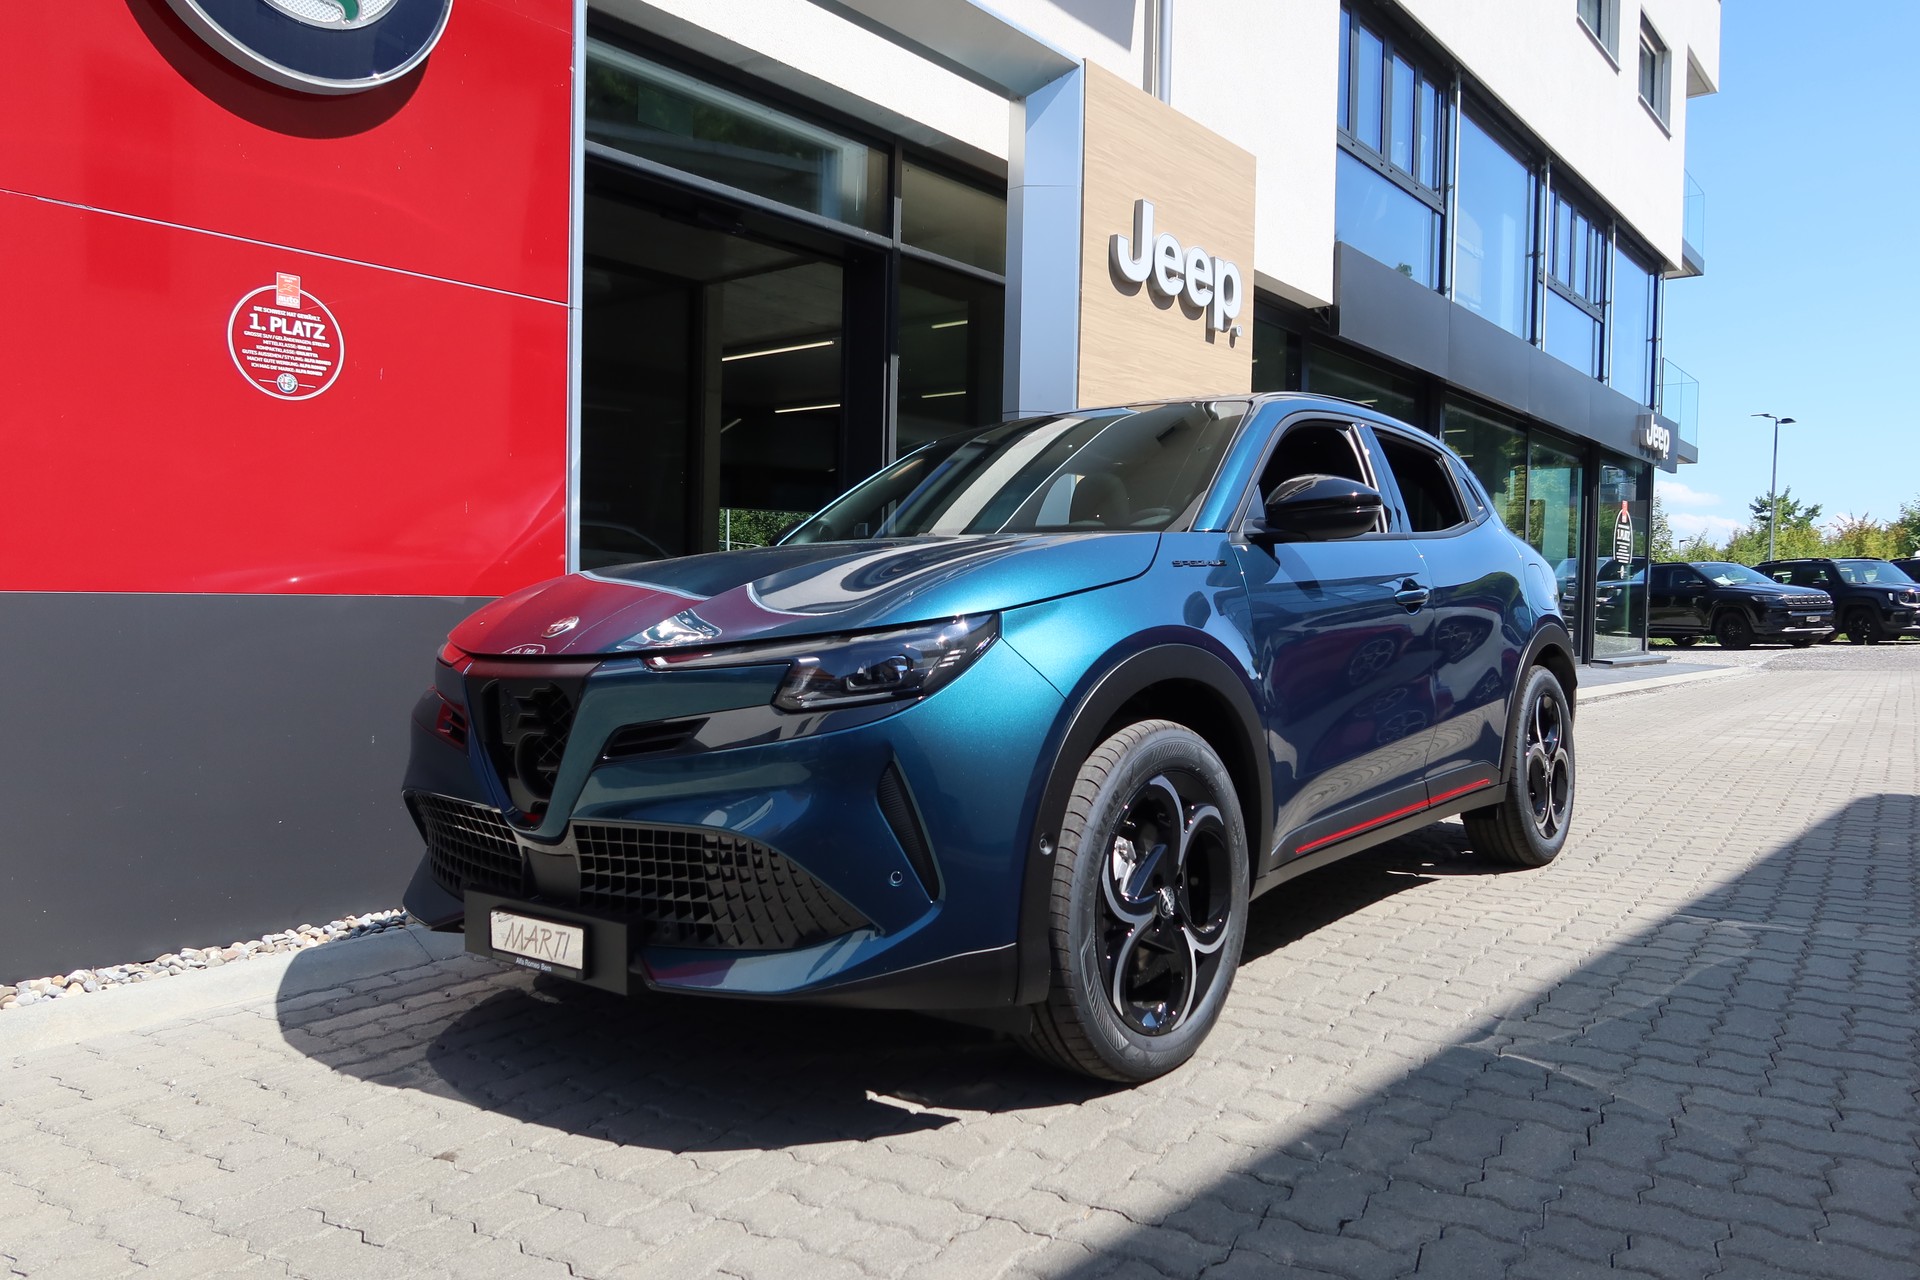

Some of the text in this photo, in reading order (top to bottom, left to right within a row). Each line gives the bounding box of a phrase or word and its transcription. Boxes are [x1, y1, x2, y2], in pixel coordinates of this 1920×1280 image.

[1109, 199, 1242, 331] Jeep
[250, 313, 325, 340] 1. PLATZ
[1646, 414, 1670, 459] Jeep
[504, 922, 570, 960] MARTI
